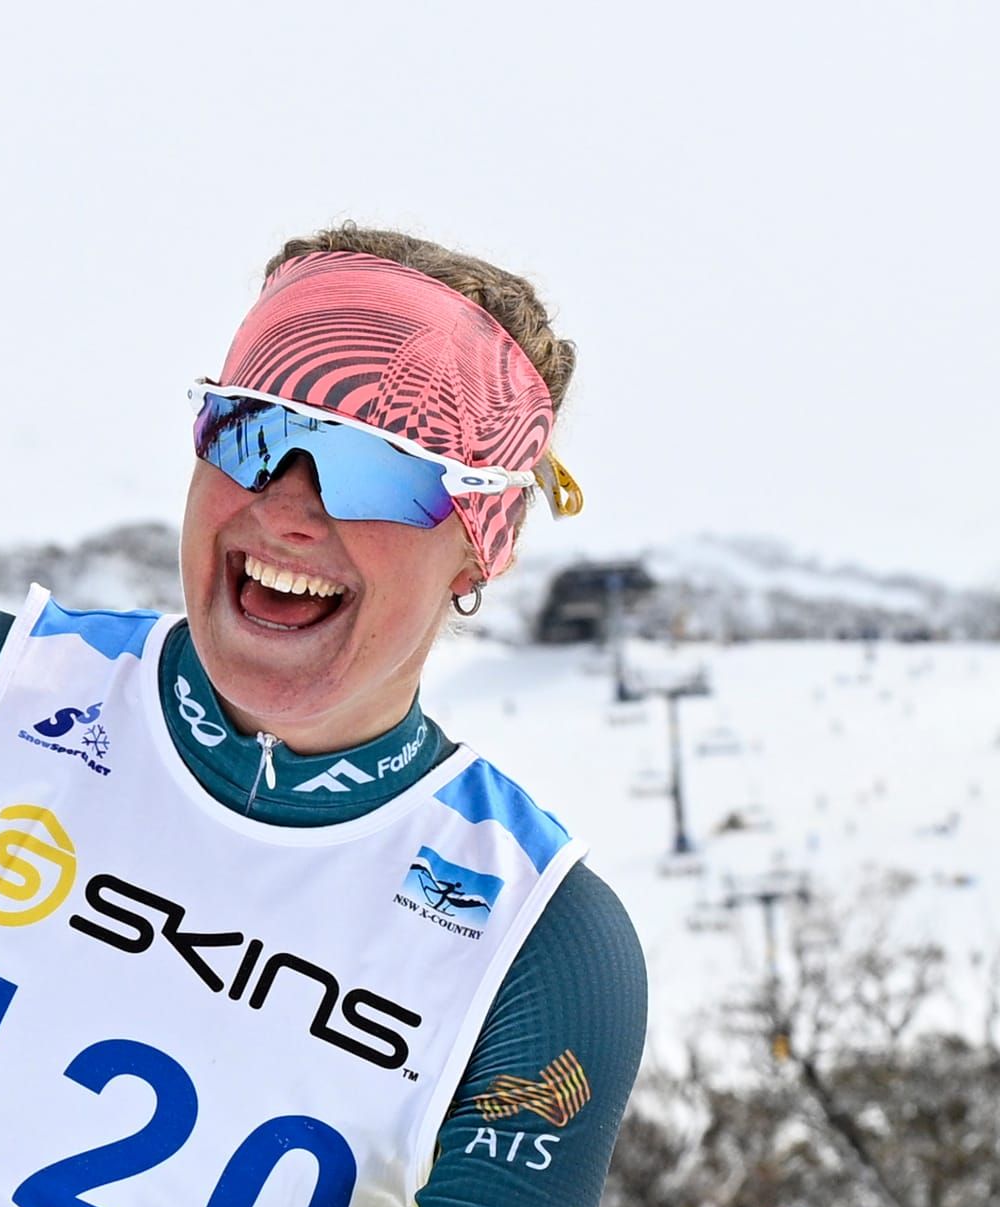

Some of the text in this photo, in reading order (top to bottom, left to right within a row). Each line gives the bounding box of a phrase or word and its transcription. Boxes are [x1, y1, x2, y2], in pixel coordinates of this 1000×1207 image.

[392, 892, 485, 941] NSW X-COUNTRY
[464, 1126, 561, 1171] AIS
